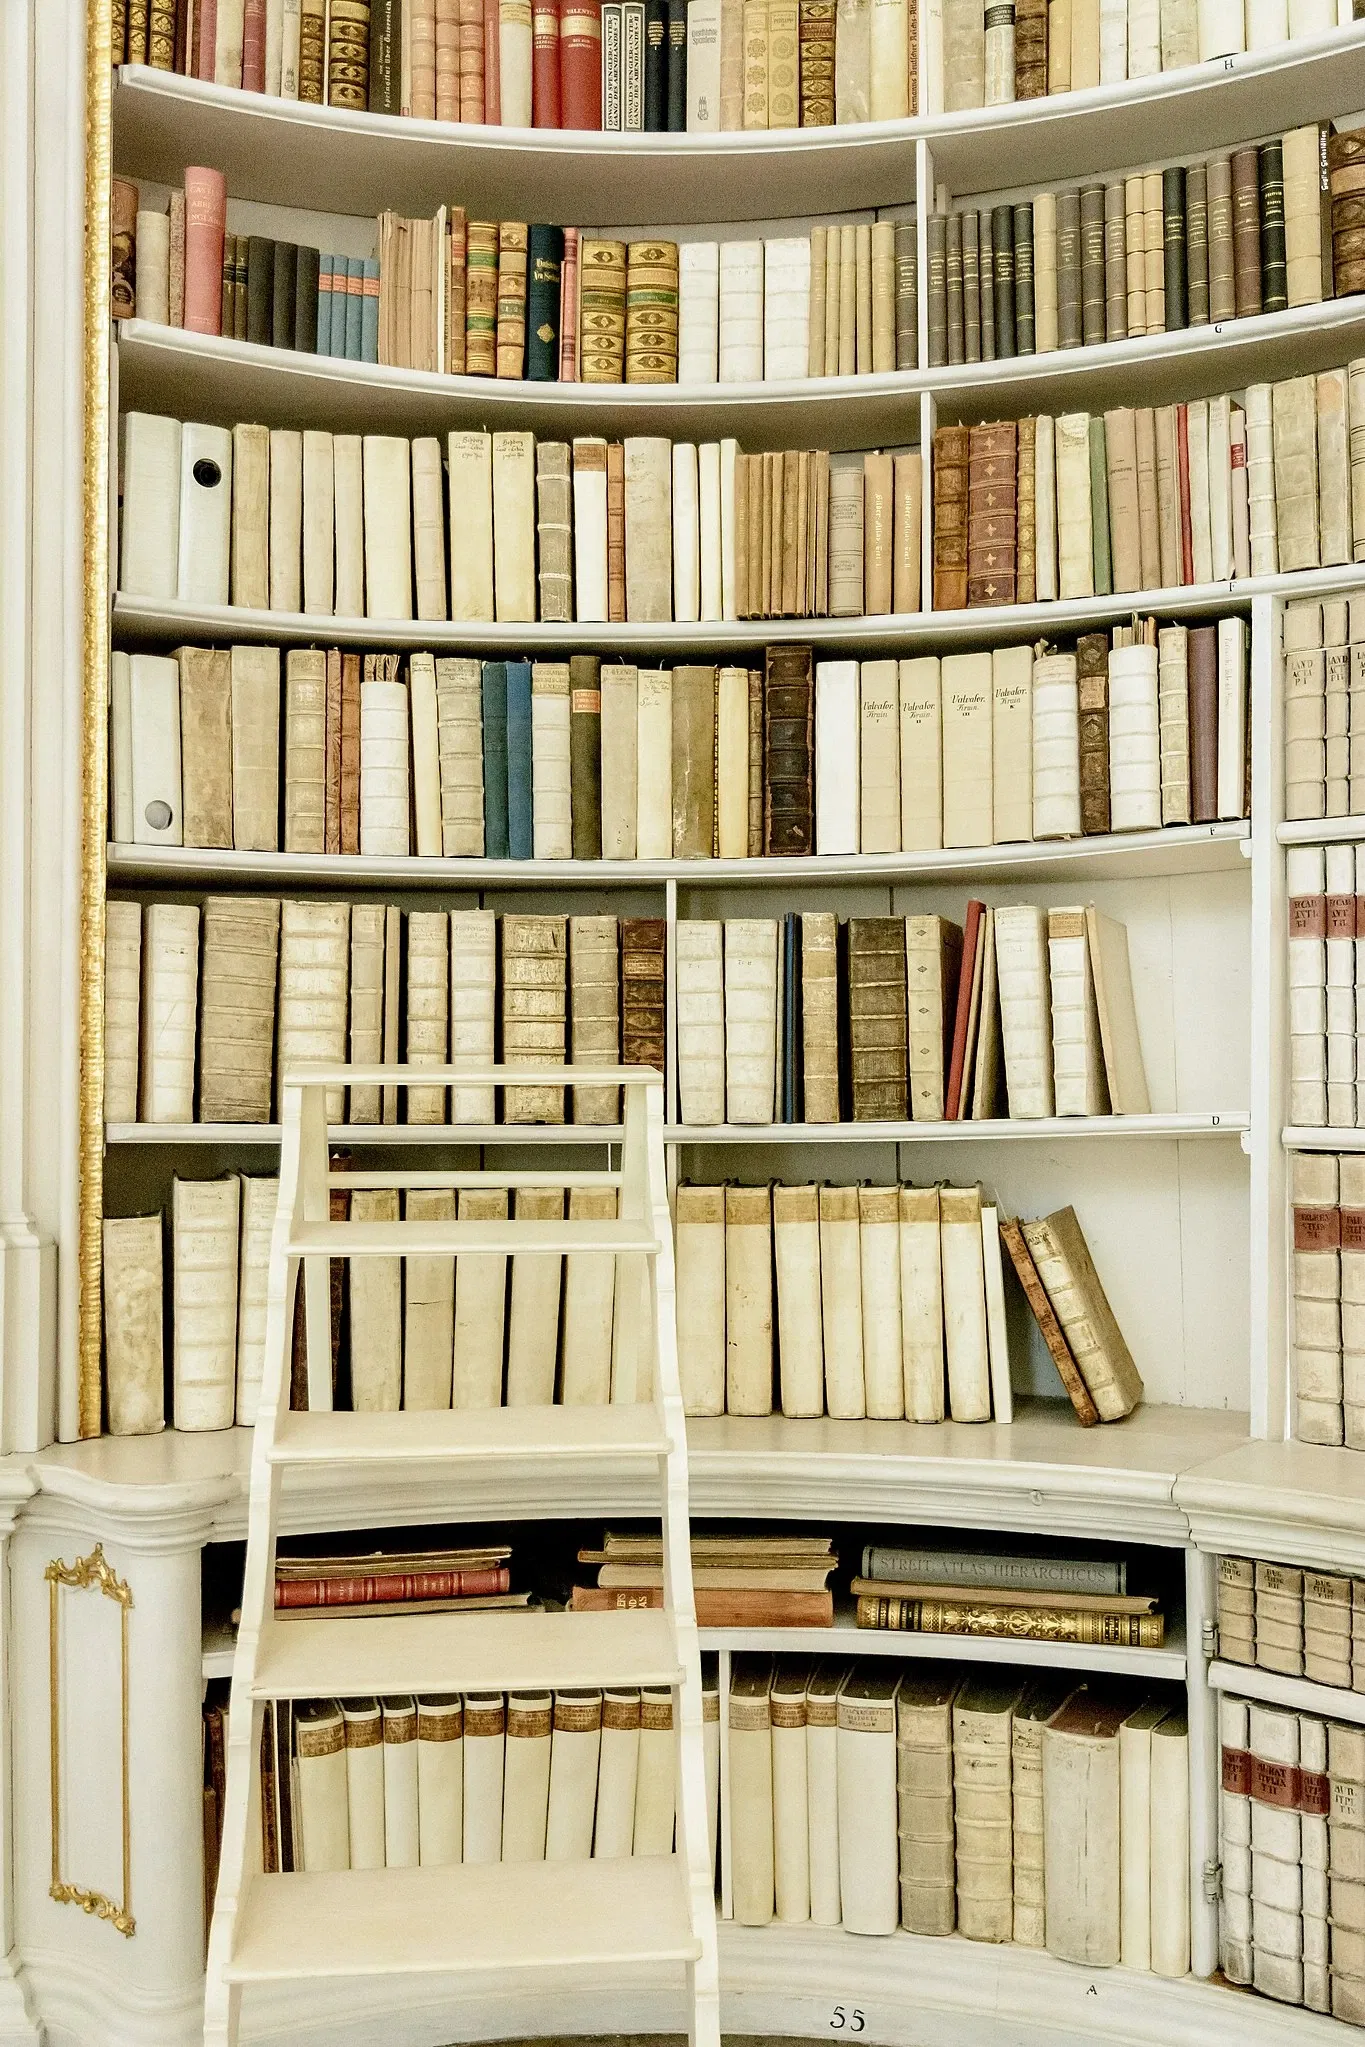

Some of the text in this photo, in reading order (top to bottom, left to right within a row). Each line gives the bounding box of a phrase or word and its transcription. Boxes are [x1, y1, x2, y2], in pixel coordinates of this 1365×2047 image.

[909, 0, 919, 42] Reichs-Atla
[1224, 58, 1234, 70] H
[1214, 323, 1222, 333] G
[1212, 1115, 1220, 1126] D
[941, 1560, 988, 1577] ATLAS
[992, 1562, 1107, 1584] HIERARCHICUS
[1086, 1984, 1098, 1996] A
[829, 2005, 866, 2033] 55
